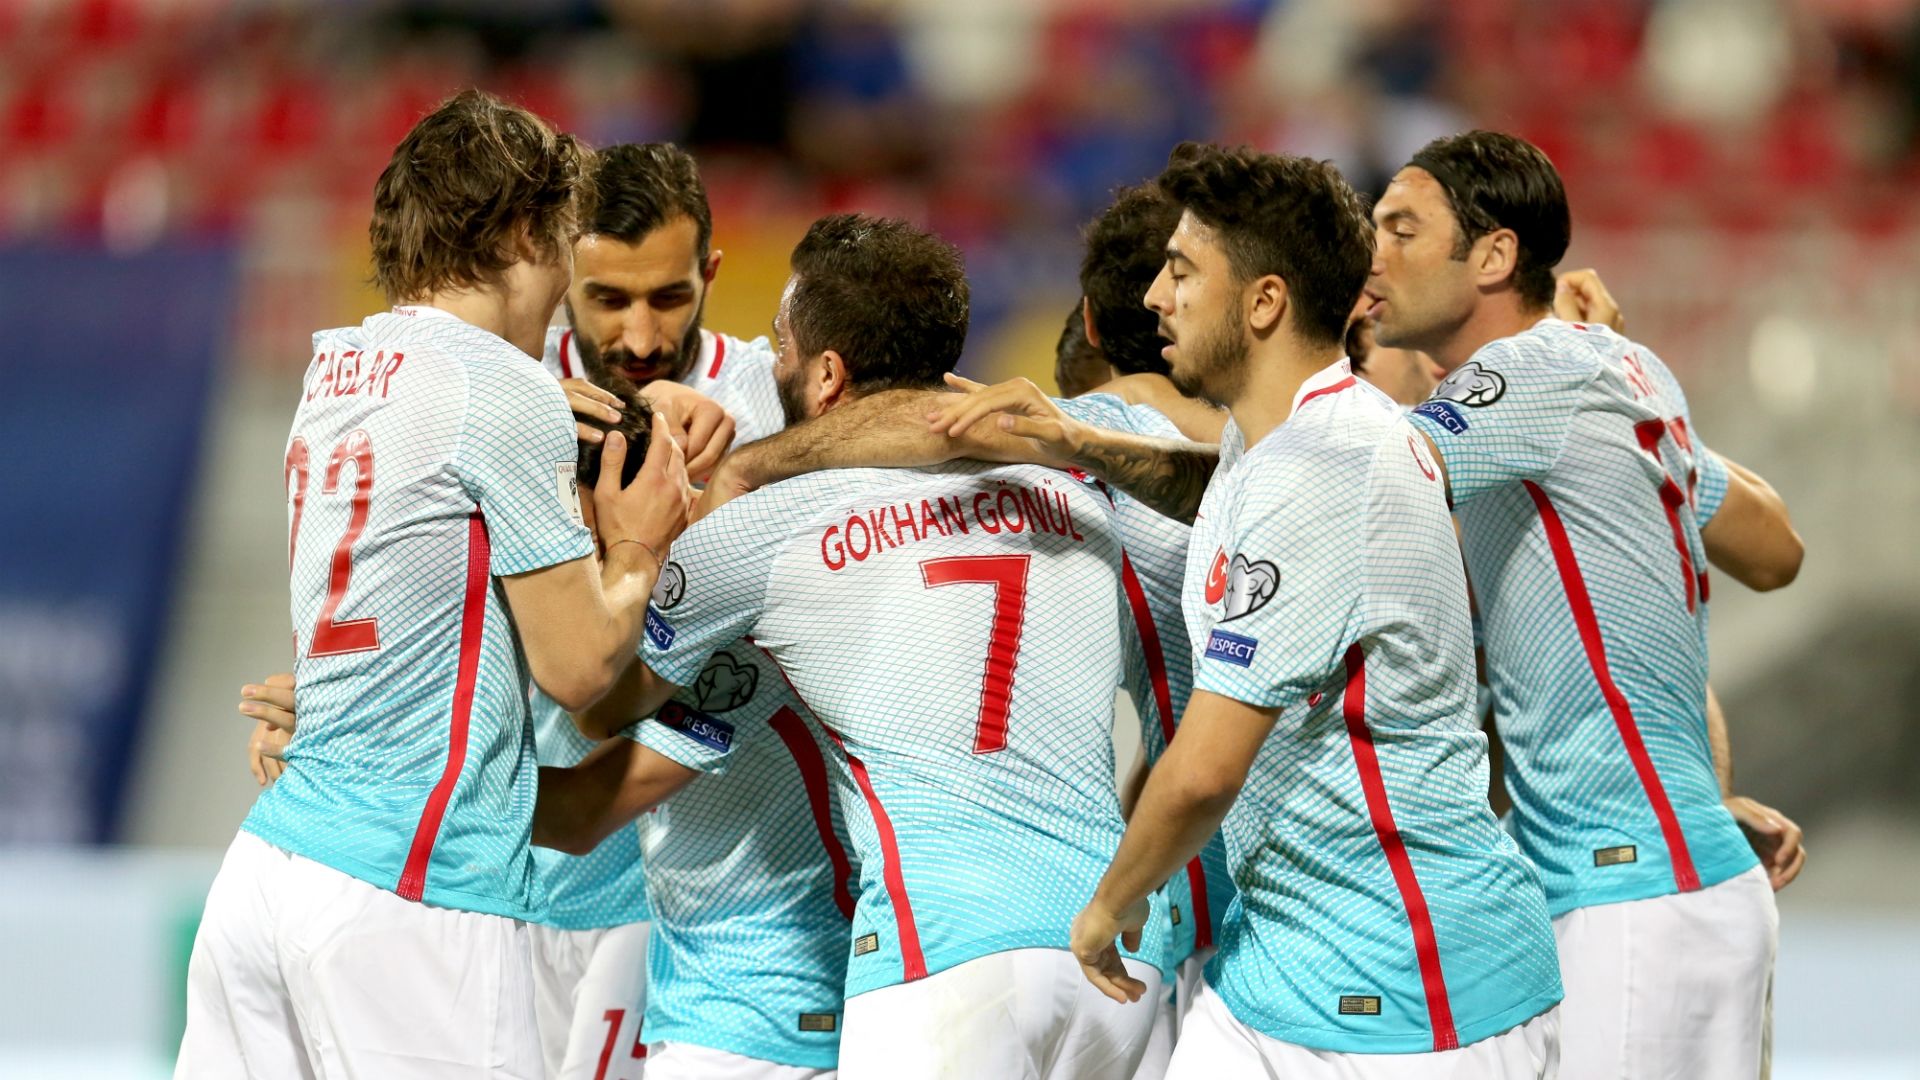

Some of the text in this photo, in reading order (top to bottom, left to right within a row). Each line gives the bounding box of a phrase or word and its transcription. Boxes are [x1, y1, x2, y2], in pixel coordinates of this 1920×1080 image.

[821, 478, 1084, 571] GÖKHAN GÖNÜL
[646, 612, 673, 645] SPECT
[918, 554, 1031, 754] 7
[682, 715, 732, 746] RESPECT
